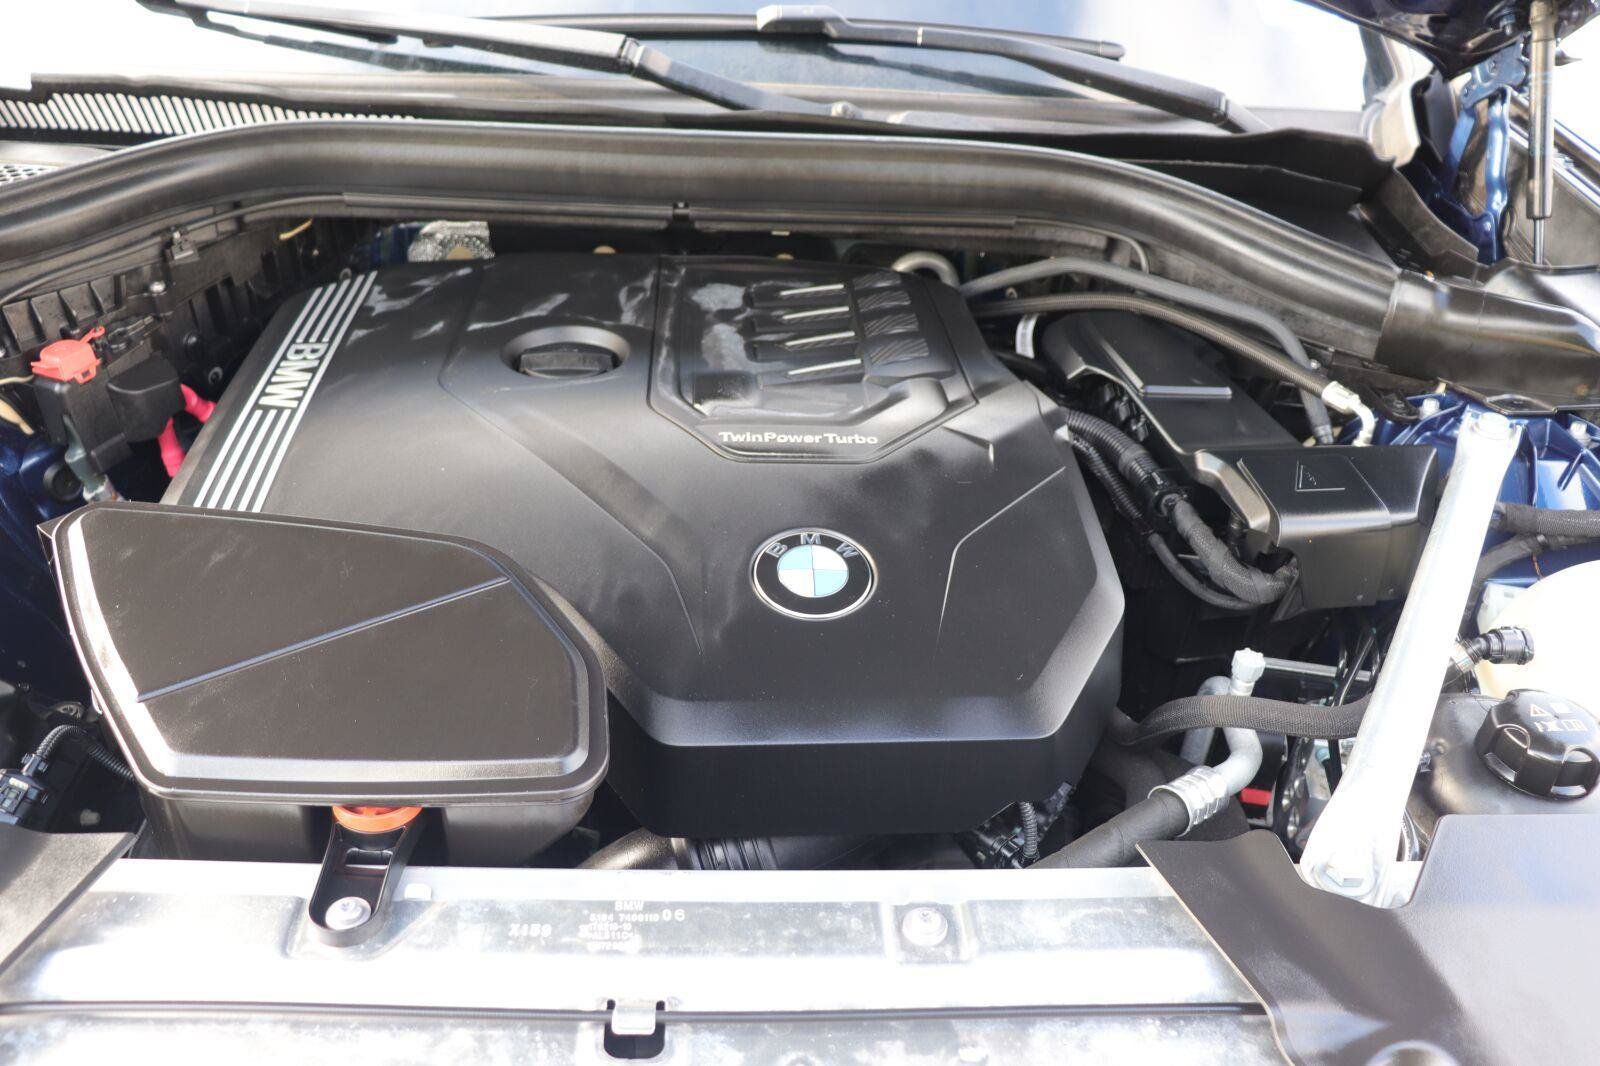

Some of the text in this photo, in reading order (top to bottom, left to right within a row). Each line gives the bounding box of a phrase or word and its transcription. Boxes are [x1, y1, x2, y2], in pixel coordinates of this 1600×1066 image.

[258, 342, 330, 408] BMW
[766, 532, 858, 558] BMW
[615, 901, 644, 911] BMW
